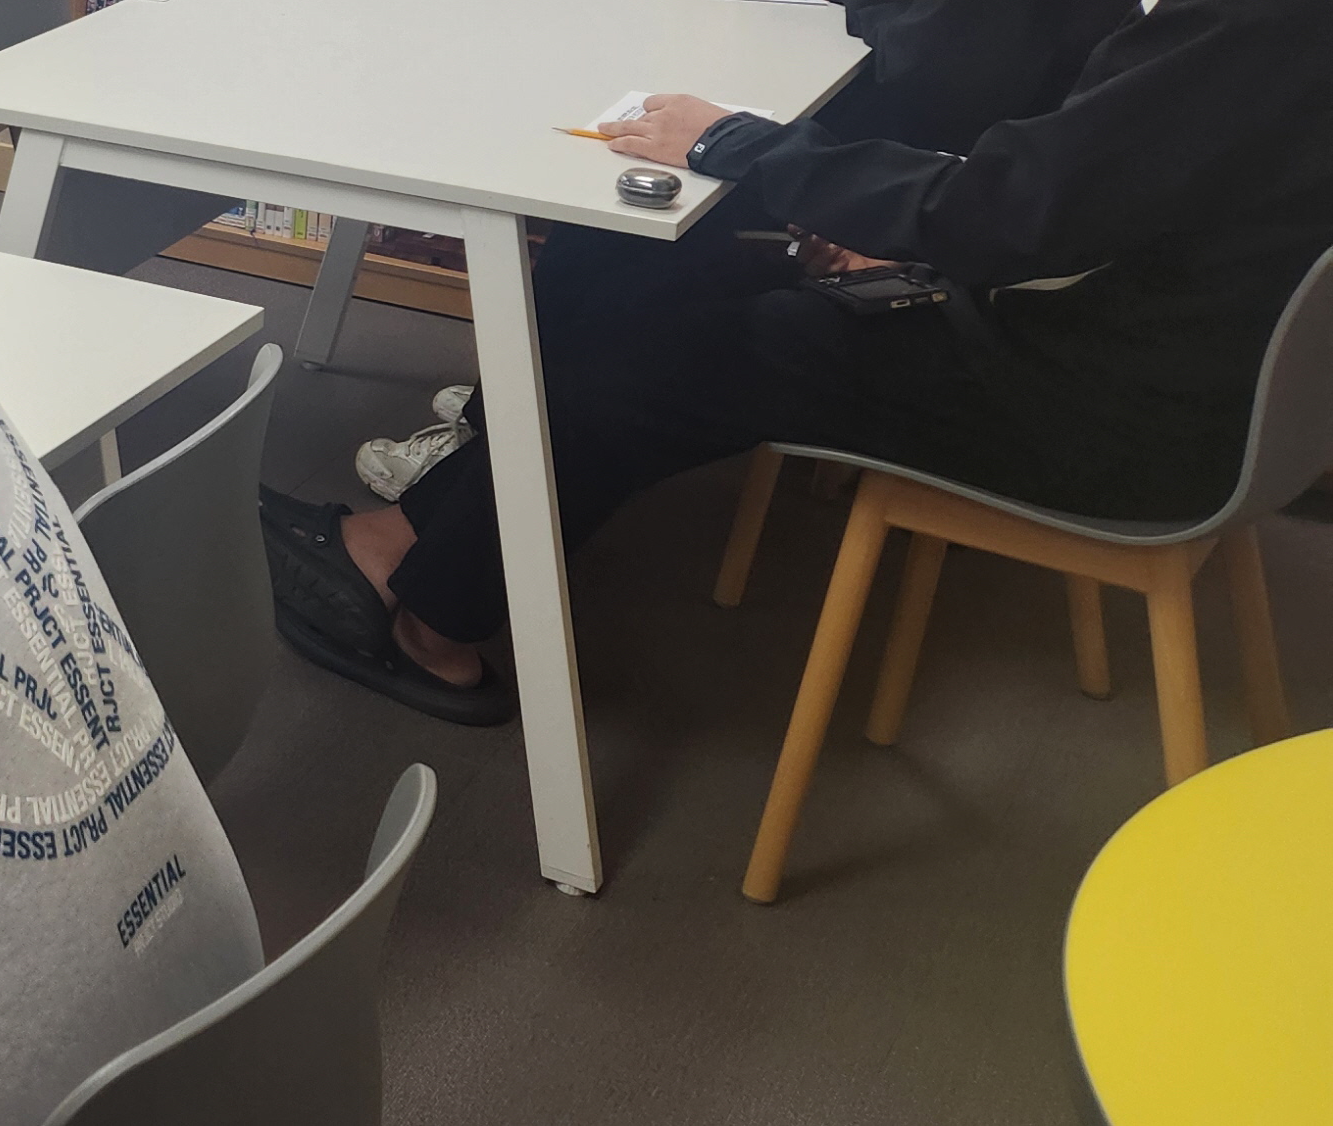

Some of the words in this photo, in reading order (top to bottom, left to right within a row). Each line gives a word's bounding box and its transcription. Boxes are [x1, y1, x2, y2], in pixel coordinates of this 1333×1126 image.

[15, 568, 67, 649] PRJCT
[2, 586, 77, 729] ESSENTIAL
[63, 805, 108, 856] PRJCT
[116, 854, 186, 949] ESSENTIAL
